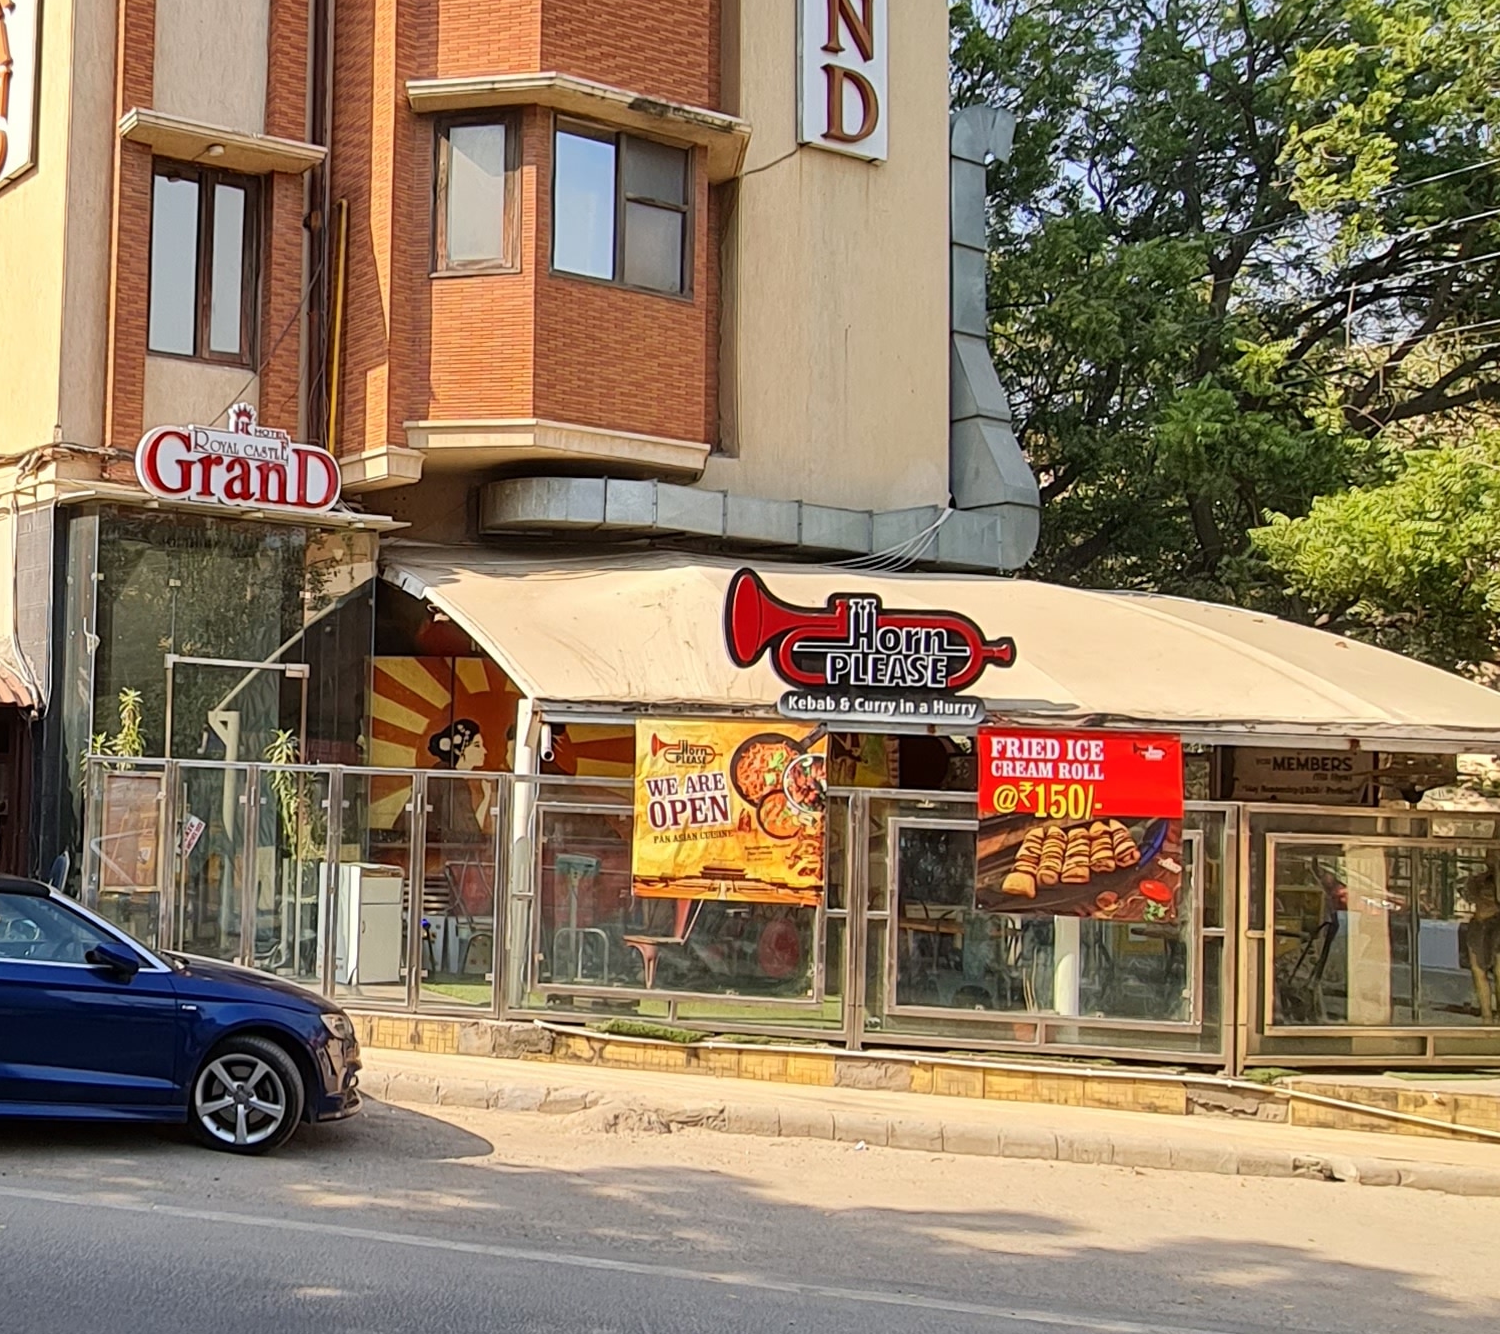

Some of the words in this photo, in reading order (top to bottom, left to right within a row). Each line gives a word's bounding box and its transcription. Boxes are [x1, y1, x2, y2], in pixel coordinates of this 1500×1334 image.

[254, 428, 287, 440] HOTEL
[243, 441, 289, 463] CASTLE
[849, 599, 948, 654] Horn
[826, 652, 948, 688] PLEASE
[788, 695, 835, 712] Kebab
[839, 696, 850, 712] &
[854, 697, 896, 716] Curry
[919, 702, 928, 714] a
[933, 699, 978, 719] Hurry
[681, 739, 708, 757] Horn
[990, 737, 1060, 760] FRIED
[1066, 739, 1105, 761] ICE
[675, 754, 707, 765] PLEASE
[990, 760, 1054, 779] CREAM
[1058, 761, 1105, 781] ROLL
[1272, 756, 1353, 772] MEMBERS
[647, 777, 679, 798] WE
[686, 772, 726, 794] ARE
[649, 794, 731, 829] OPEN
[653, 834, 671, 844] PAN
[673, 832, 698, 843] ASIAN
[700, 829, 734, 841] CUISINE
